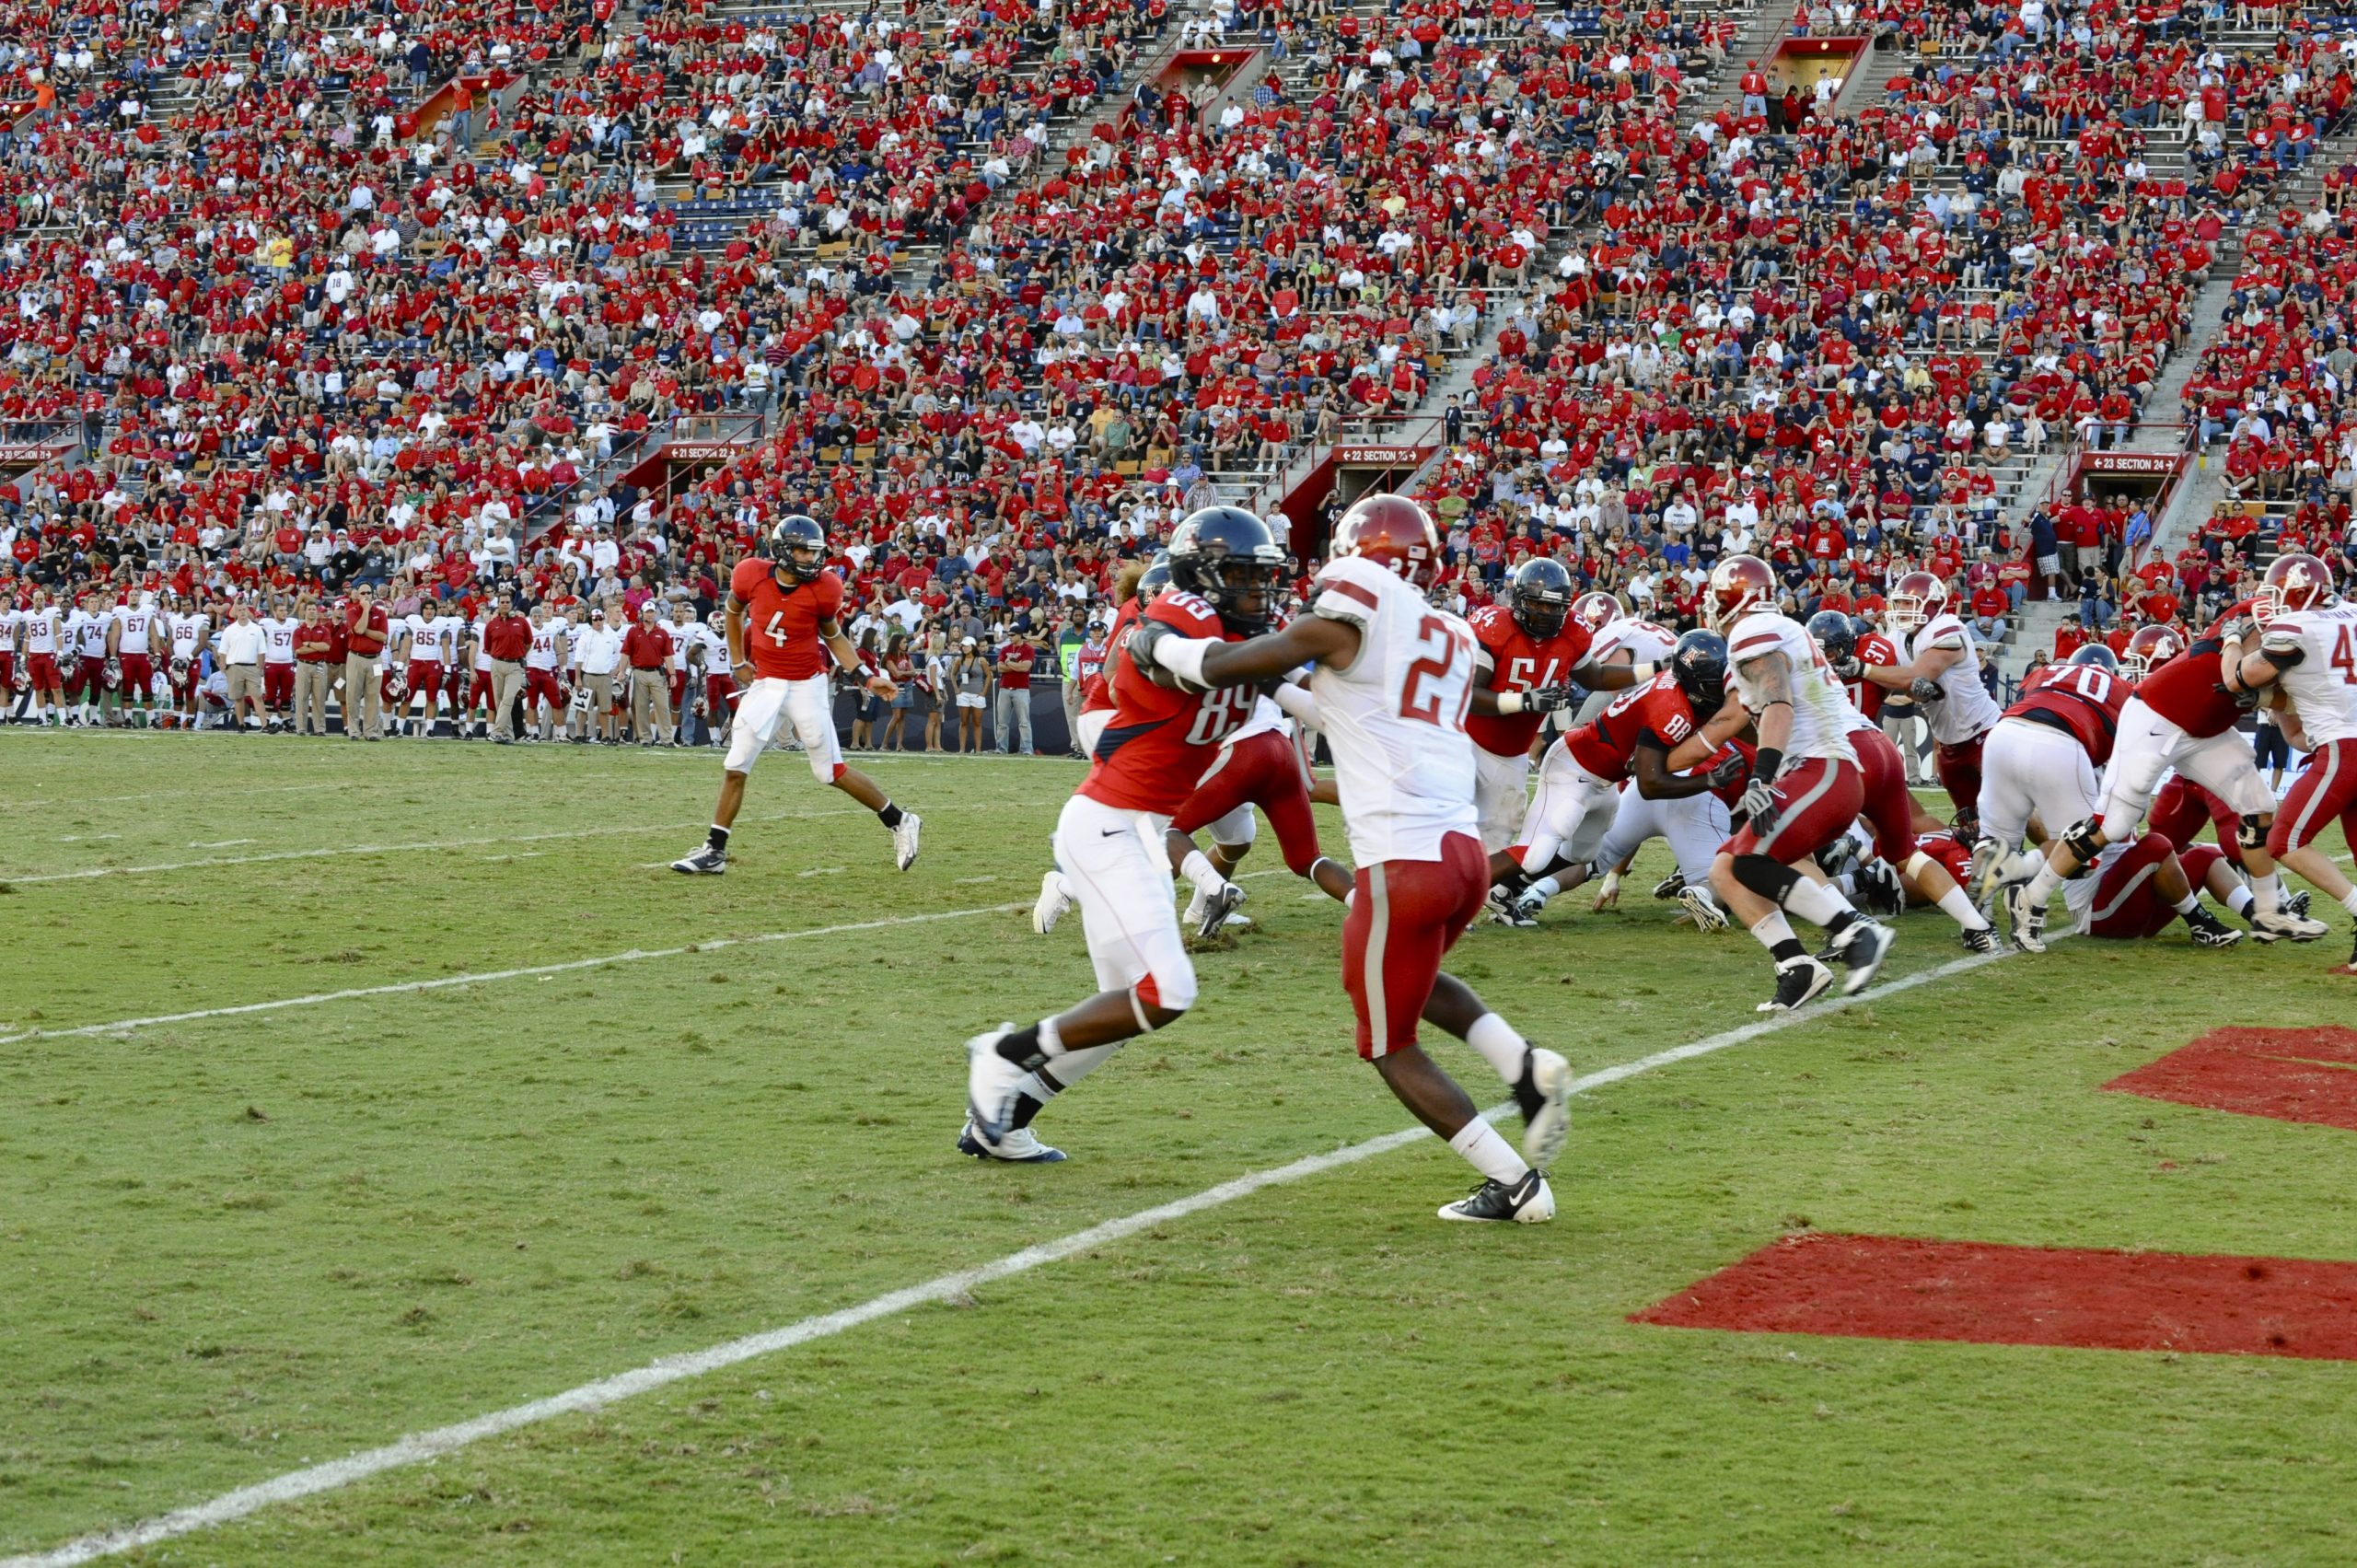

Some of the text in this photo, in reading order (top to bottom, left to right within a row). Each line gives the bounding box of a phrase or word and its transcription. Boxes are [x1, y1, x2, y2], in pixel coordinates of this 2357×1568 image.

[1749, 75, 1757, 88] 7
[1199, 433, 1206, 443] 7
[14, 450, 38, 459] SECTION
[679, 447, 727, 459] 21 SECTION 22
[1352, 450, 1362, 460] 22
[1364, 451, 1396, 460] SECTION
[2104, 458, 2164, 470] 23 SECTION 24
[1470, 606, 1498, 628] 54
[30, 621, 48, 637] 83
[87, 625, 102, 640] 74
[127, 618, 145, 633] 67
[175, 626, 193, 640] 66
[764, 610, 788, 648] 4
[274, 632, 292, 646] 57
[416, 631, 435, 646] 85
[533, 636, 552, 654] 44
[718, 647, 727, 662] 3
[1680, 645, 1703, 670] A
[2331, 623, 2357, 685] 4
[1508, 657, 1561, 693] 54
[2040, 665, 2111, 704] 70
[573, 691, 590, 711] 31
[1184, 683, 1259, 746] 89
[1663, 713, 1692, 743] 88
